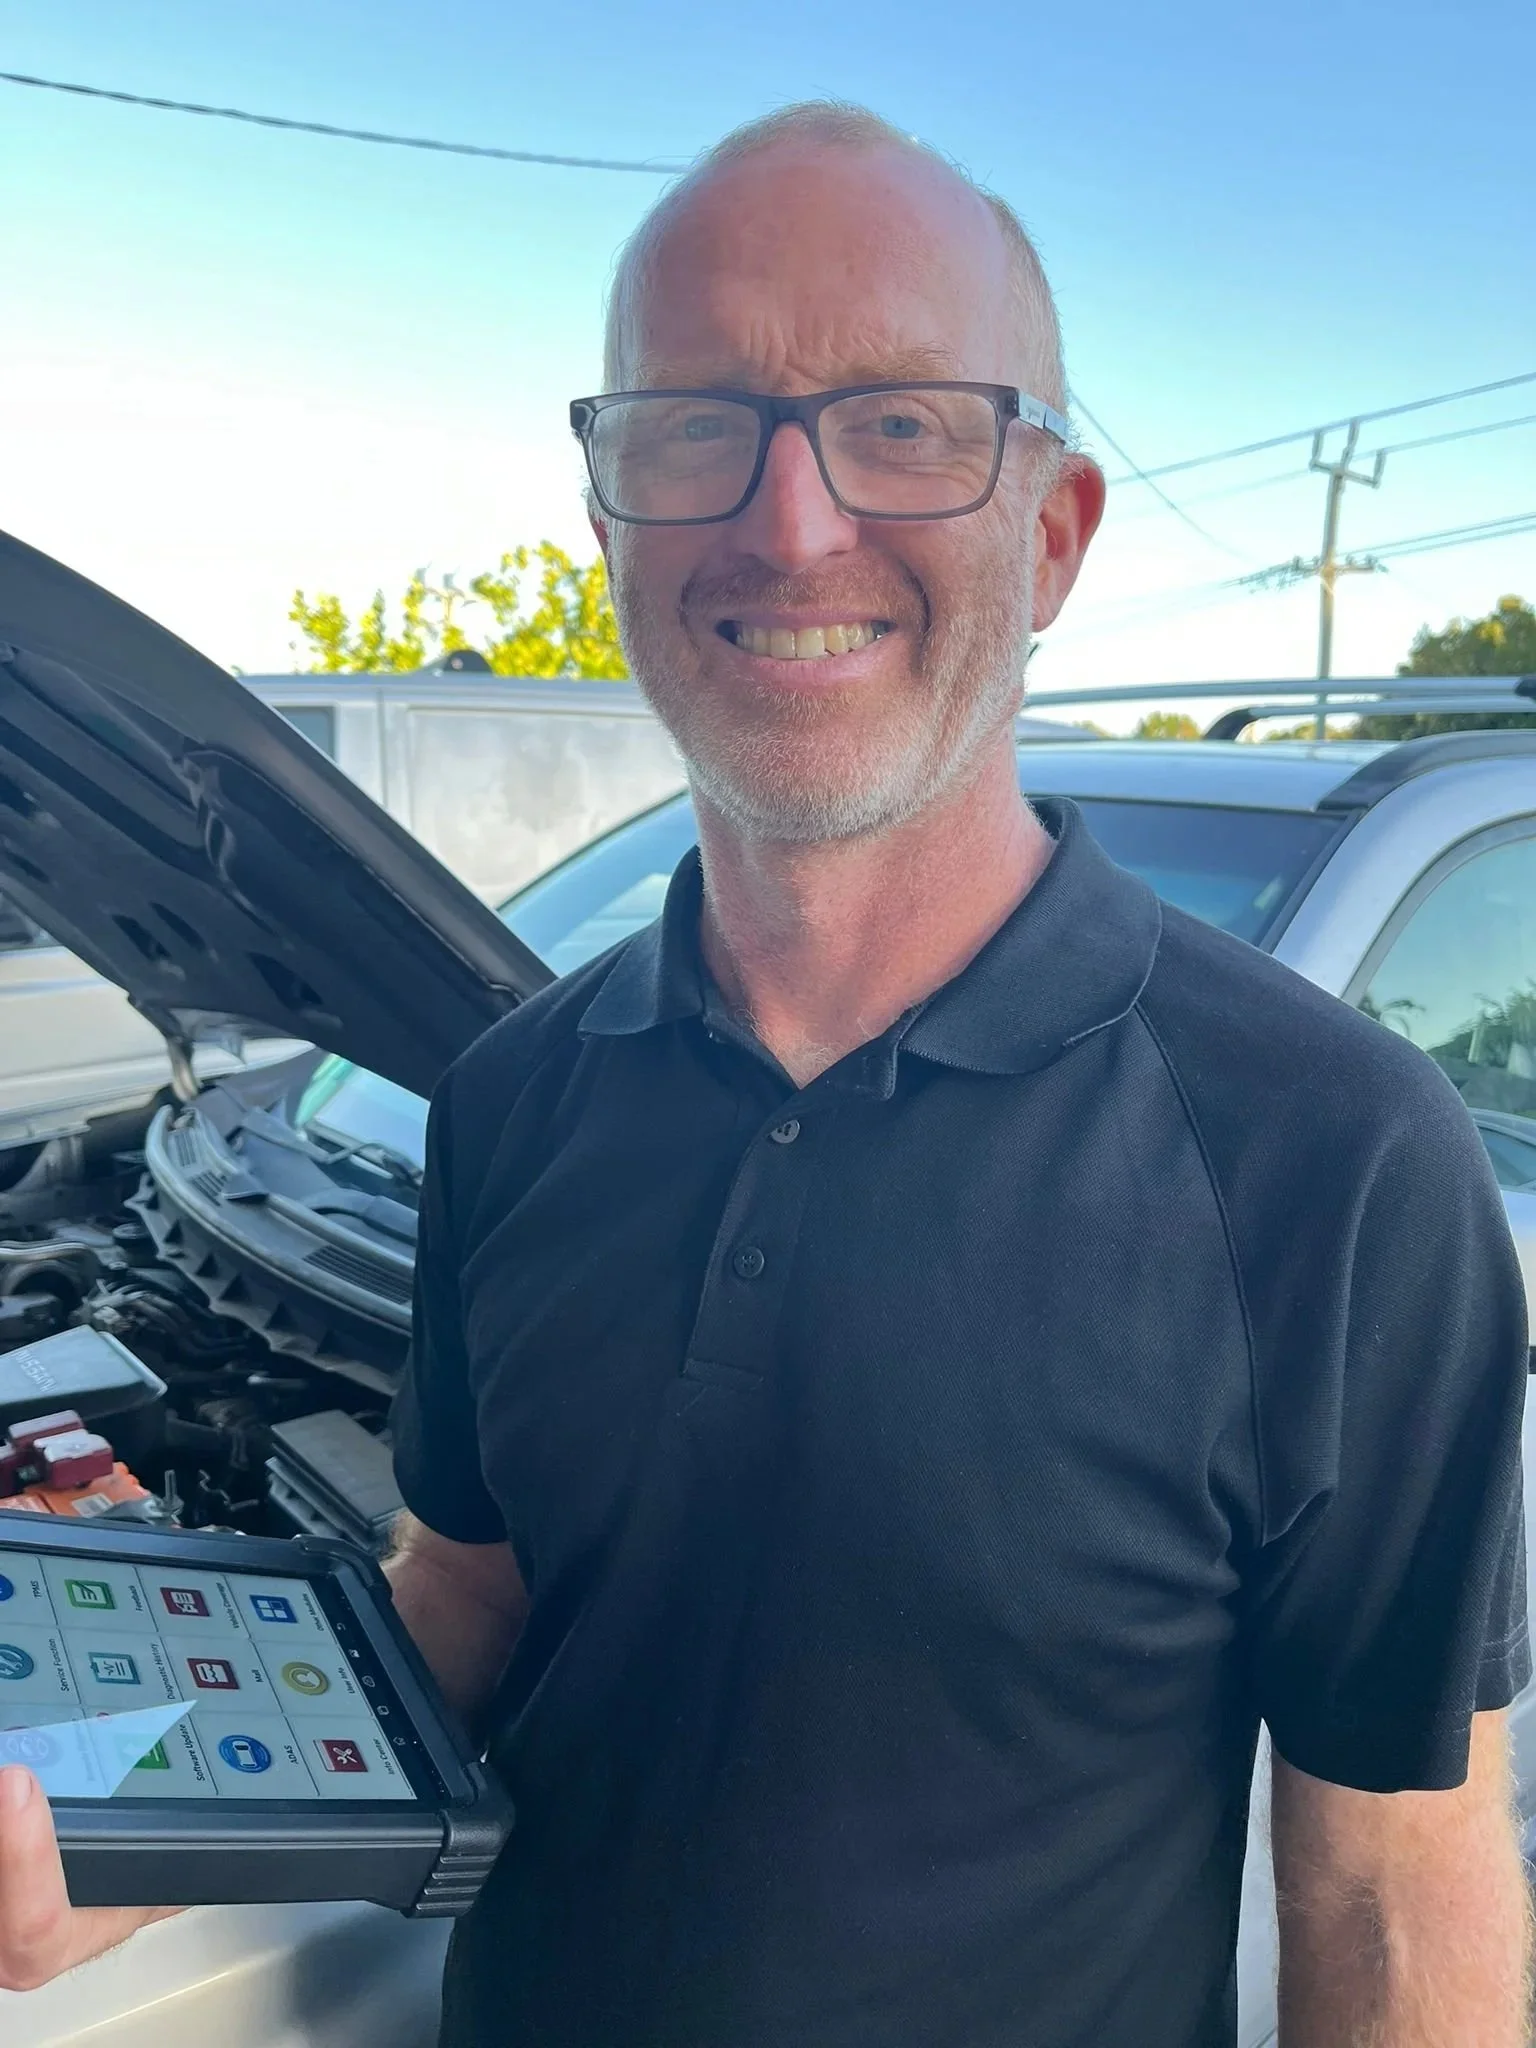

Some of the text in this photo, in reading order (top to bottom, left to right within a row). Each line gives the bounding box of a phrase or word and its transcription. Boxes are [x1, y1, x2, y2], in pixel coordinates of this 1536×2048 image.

[30, 1580, 42, 1598] TPMS
[128, 1584, 144, 1612] Feedback
[48, 1638, 70, 1692] Service Function
[150, 1643, 175, 1700] Diagnostic History
[337, 1667, 356, 1694] User Info
[179, 1724, 206, 1782] Software Update
[283, 1744, 299, 1765] ADAS
[373, 1738, 395, 1776] Info Center
